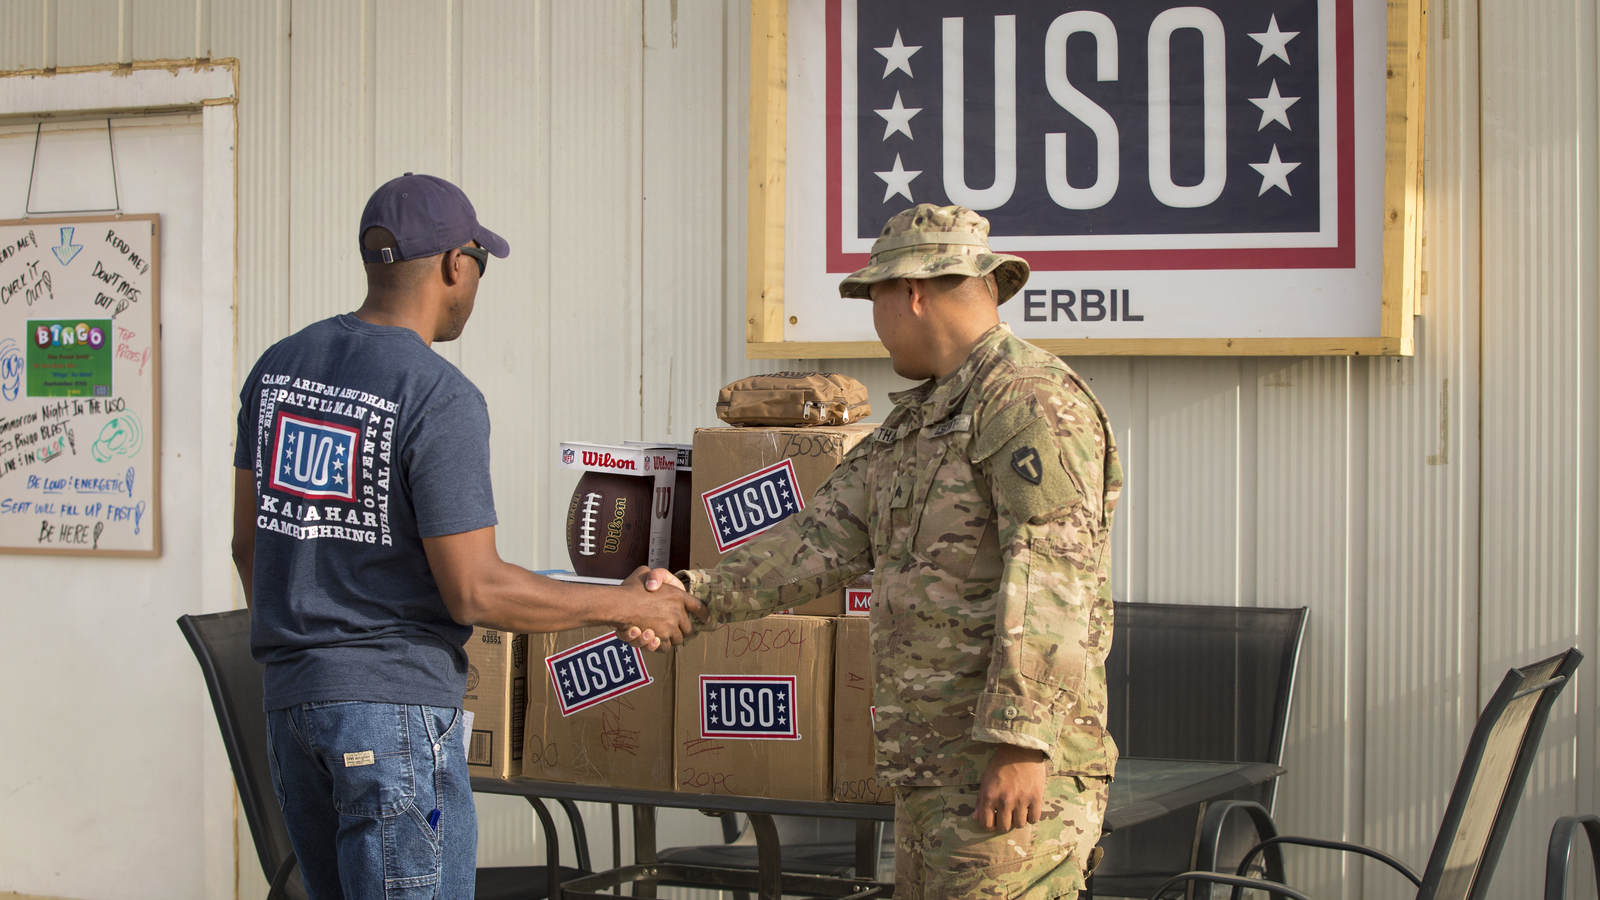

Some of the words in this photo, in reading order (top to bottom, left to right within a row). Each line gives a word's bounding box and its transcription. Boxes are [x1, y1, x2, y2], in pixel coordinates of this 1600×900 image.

[942, 6, 1227, 211] USO
[0, 245, 15, 263] EAD
[105, 229, 130, 256] READ
[91, 260, 121, 287] DON'T
[1, 272, 27, 305] CHECK
[1023, 289, 1144, 323] ERBIL
[37, 326, 103, 346] BINGO
[261, 373, 291, 386] CAMP
[104, 396, 126, 415] USO
[263, 388, 279, 428] ERBIL
[24, 450, 36, 466] IN
[36, 435, 66, 463] COLOR
[362, 411, 382, 481] FENTY
[379, 417, 396, 464] ASAD
[582, 449, 636, 471] Wilson
[653, 455, 675, 471] Wilson
[26, 474, 42, 490] BE
[42, 475, 67, 493] LOUD
[378, 467, 390, 491] AL
[0, 497, 32, 515] SEAT
[85, 503, 102, 518] UP
[377, 494, 393, 547] DUBAI
[725, 480, 783, 533] USO
[38, 519, 55, 544] BE
[603, 497, 627, 554] Wilson
[568, 645, 625, 697] USO
[720, 687, 775, 727] USO
